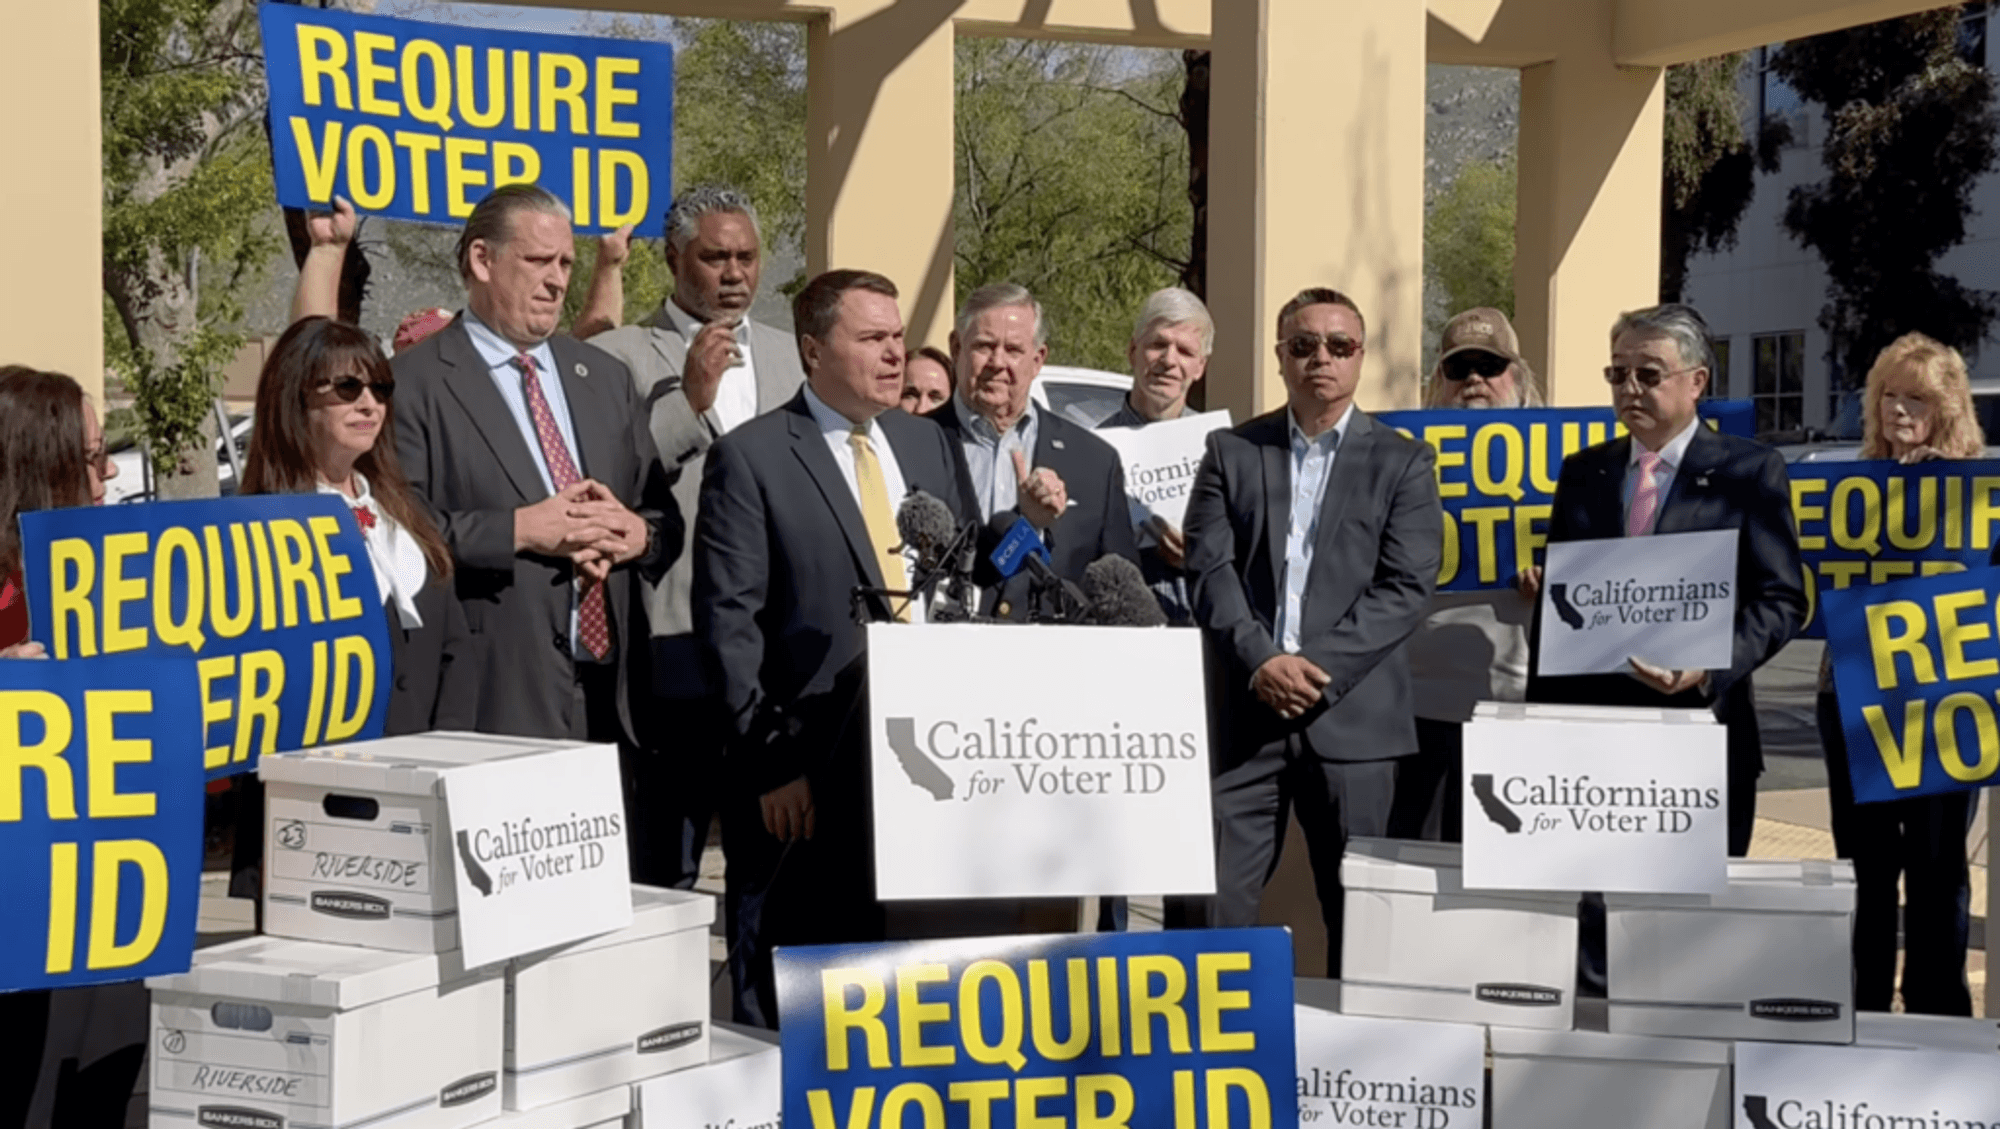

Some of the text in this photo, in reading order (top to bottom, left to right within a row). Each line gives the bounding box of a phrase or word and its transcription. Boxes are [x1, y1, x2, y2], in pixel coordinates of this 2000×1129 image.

[296, 23, 641, 139] REQUIRE
[290, 116, 650, 231] VOTER ID
[1788, 476, 2000, 557] EQUIR
[50, 516, 363, 661] REQUIRE
[1572, 578, 1730, 607] Californians
[1587, 602, 1709, 631] for Voter ID
[302, 635, 376, 747] ID
[928, 717, 1197, 760] Californians
[962, 762, 1166, 801] for Voter ID
[1502, 775, 1720, 809] Californians
[474, 812, 621, 862] Californians
[1528, 808, 1693, 835] for Voter ID
[311, 852, 422, 887] RIVERSIDE
[496, 842, 605, 895] for Voter ID
[46, 839, 169, 974] ID
[315, 896, 386, 913] BANKERS BOX
[821, 952, 1256, 1072] REQUIRE
[1481, 988, 1556, 1001] BANKERS BOX
[1755, 1005, 1834, 1015] BANKERS BOX
[192, 1064, 302, 1097] RIVERSIDE
[1173, 1067, 1272, 1129] ID
[1296, 1067, 1477, 1109] alifornians
[203, 1111, 279, 1129] BANKERS BOX
[1330, 1101, 1407, 1128] Voter
[1415, 1106, 1449, 1129] ID
[1776, 1100, 2000, 1129] Californi
